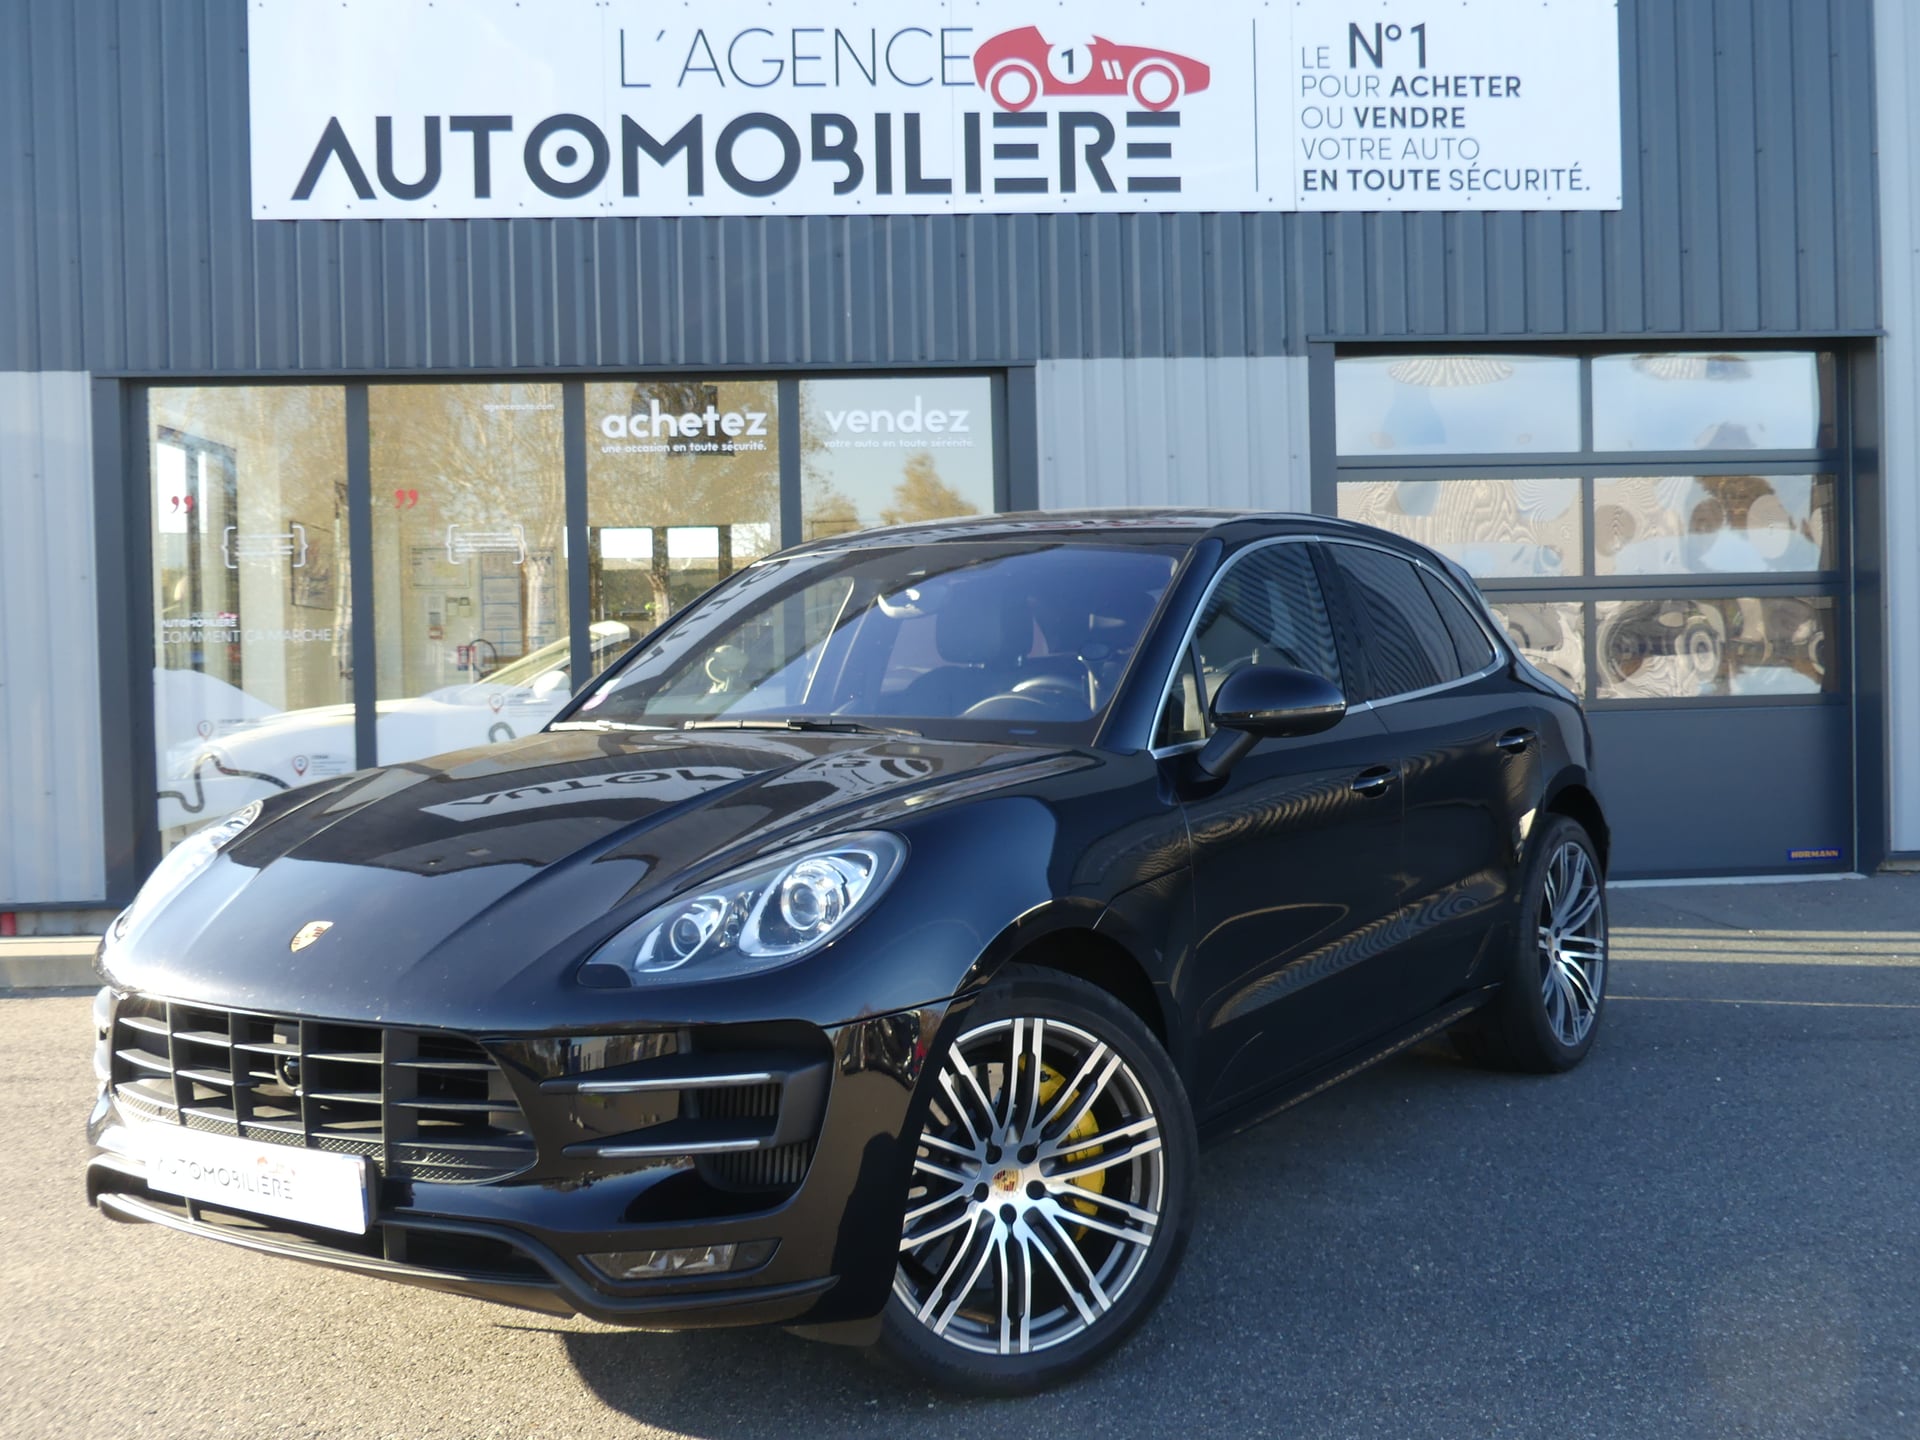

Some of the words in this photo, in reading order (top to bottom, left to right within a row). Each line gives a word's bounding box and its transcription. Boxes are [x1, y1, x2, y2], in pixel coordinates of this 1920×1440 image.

[1301, 46, 1331, 69] LE
[1301, 75, 1380, 98] POUR
[1390, 75, 1522, 98] ACHETER
[1301, 106, 1343, 129] OU
[1354, 106, 1466, 128] VENDRE
[291, 111, 1182, 201] AUTOMOBILIERE
[1301, 137, 1392, 160] VOTRE
[1401, 137, 1480, 160] AUTO
[1303, 169, 1338, 191] EN
[1347, 169, 1441, 191] TOUTE
[1449, 162, 1591, 191] SÉCURITÉ.
[601, 399, 768, 438] achetez
[824, 395, 971, 433] vendez
[601, 444, 622, 454] une
[622, 442, 670, 454] occasion
[672, 443, 687, 453] en
[689, 441, 719, 452] toute
[721, 439, 767, 452] sécurité.
[854, 439, 880, 449] auto
[900, 438, 928, 449] toute
[162, 630, 241, 643] COMMENT
